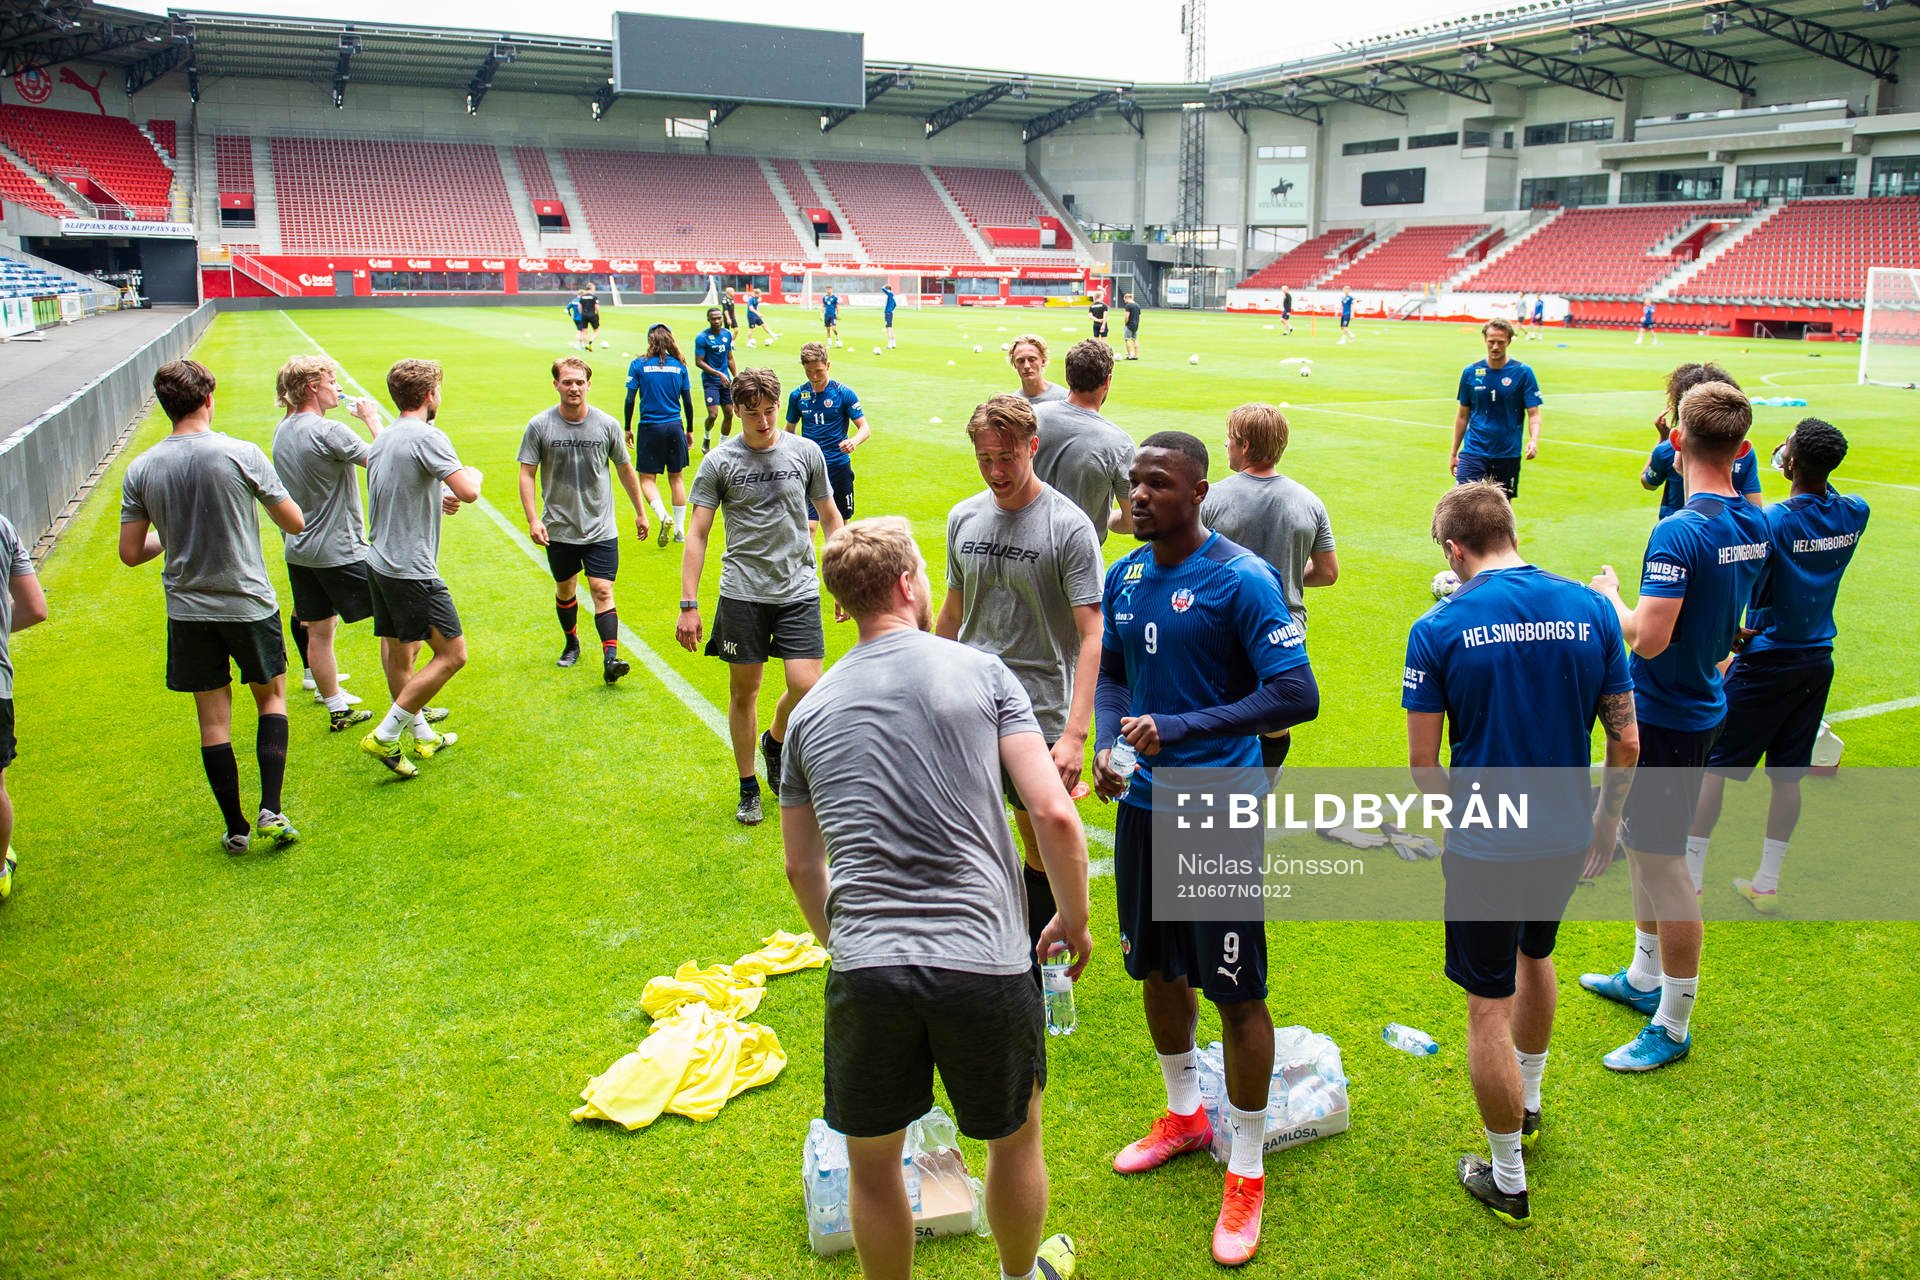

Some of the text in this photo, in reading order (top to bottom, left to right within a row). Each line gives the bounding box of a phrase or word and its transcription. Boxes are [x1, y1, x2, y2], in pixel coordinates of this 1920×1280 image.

[1490, 389, 1497, 402] 1
[813, 412, 825, 425] 11
[1793, 534, 1854, 553] HELSINGBORGS
[1144, 621, 1158, 655] 9
[1267, 624, 1299, 645] UNIB
[1462, 621, 1591, 649] HELSINGBORGS IF
[1223, 931, 1240, 964] 9
[1262, 1127, 1318, 1151] RAMLÖSA
